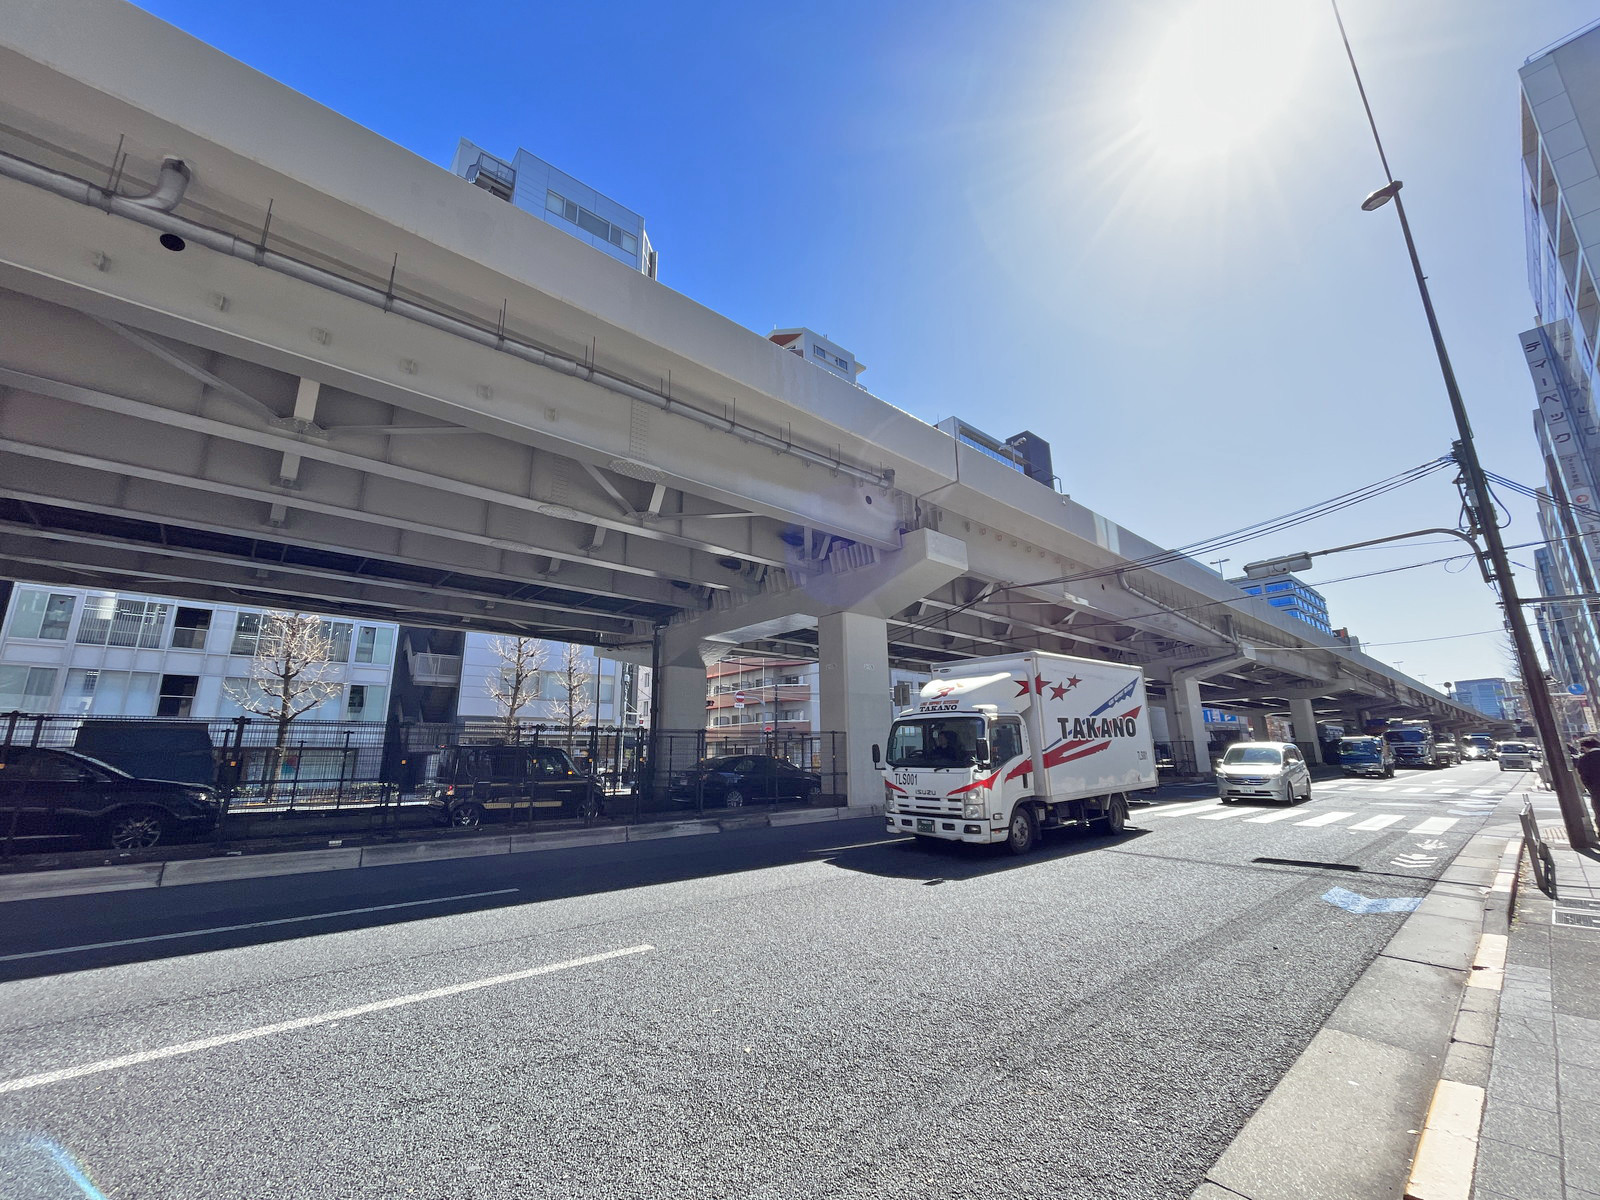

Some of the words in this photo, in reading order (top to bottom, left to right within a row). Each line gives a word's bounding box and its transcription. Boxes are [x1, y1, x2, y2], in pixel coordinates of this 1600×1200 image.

[920, 704, 957, 712] TAKANO
[1057, 717, 1137, 740] TAKANO
[894, 773, 918, 786] TLS001
